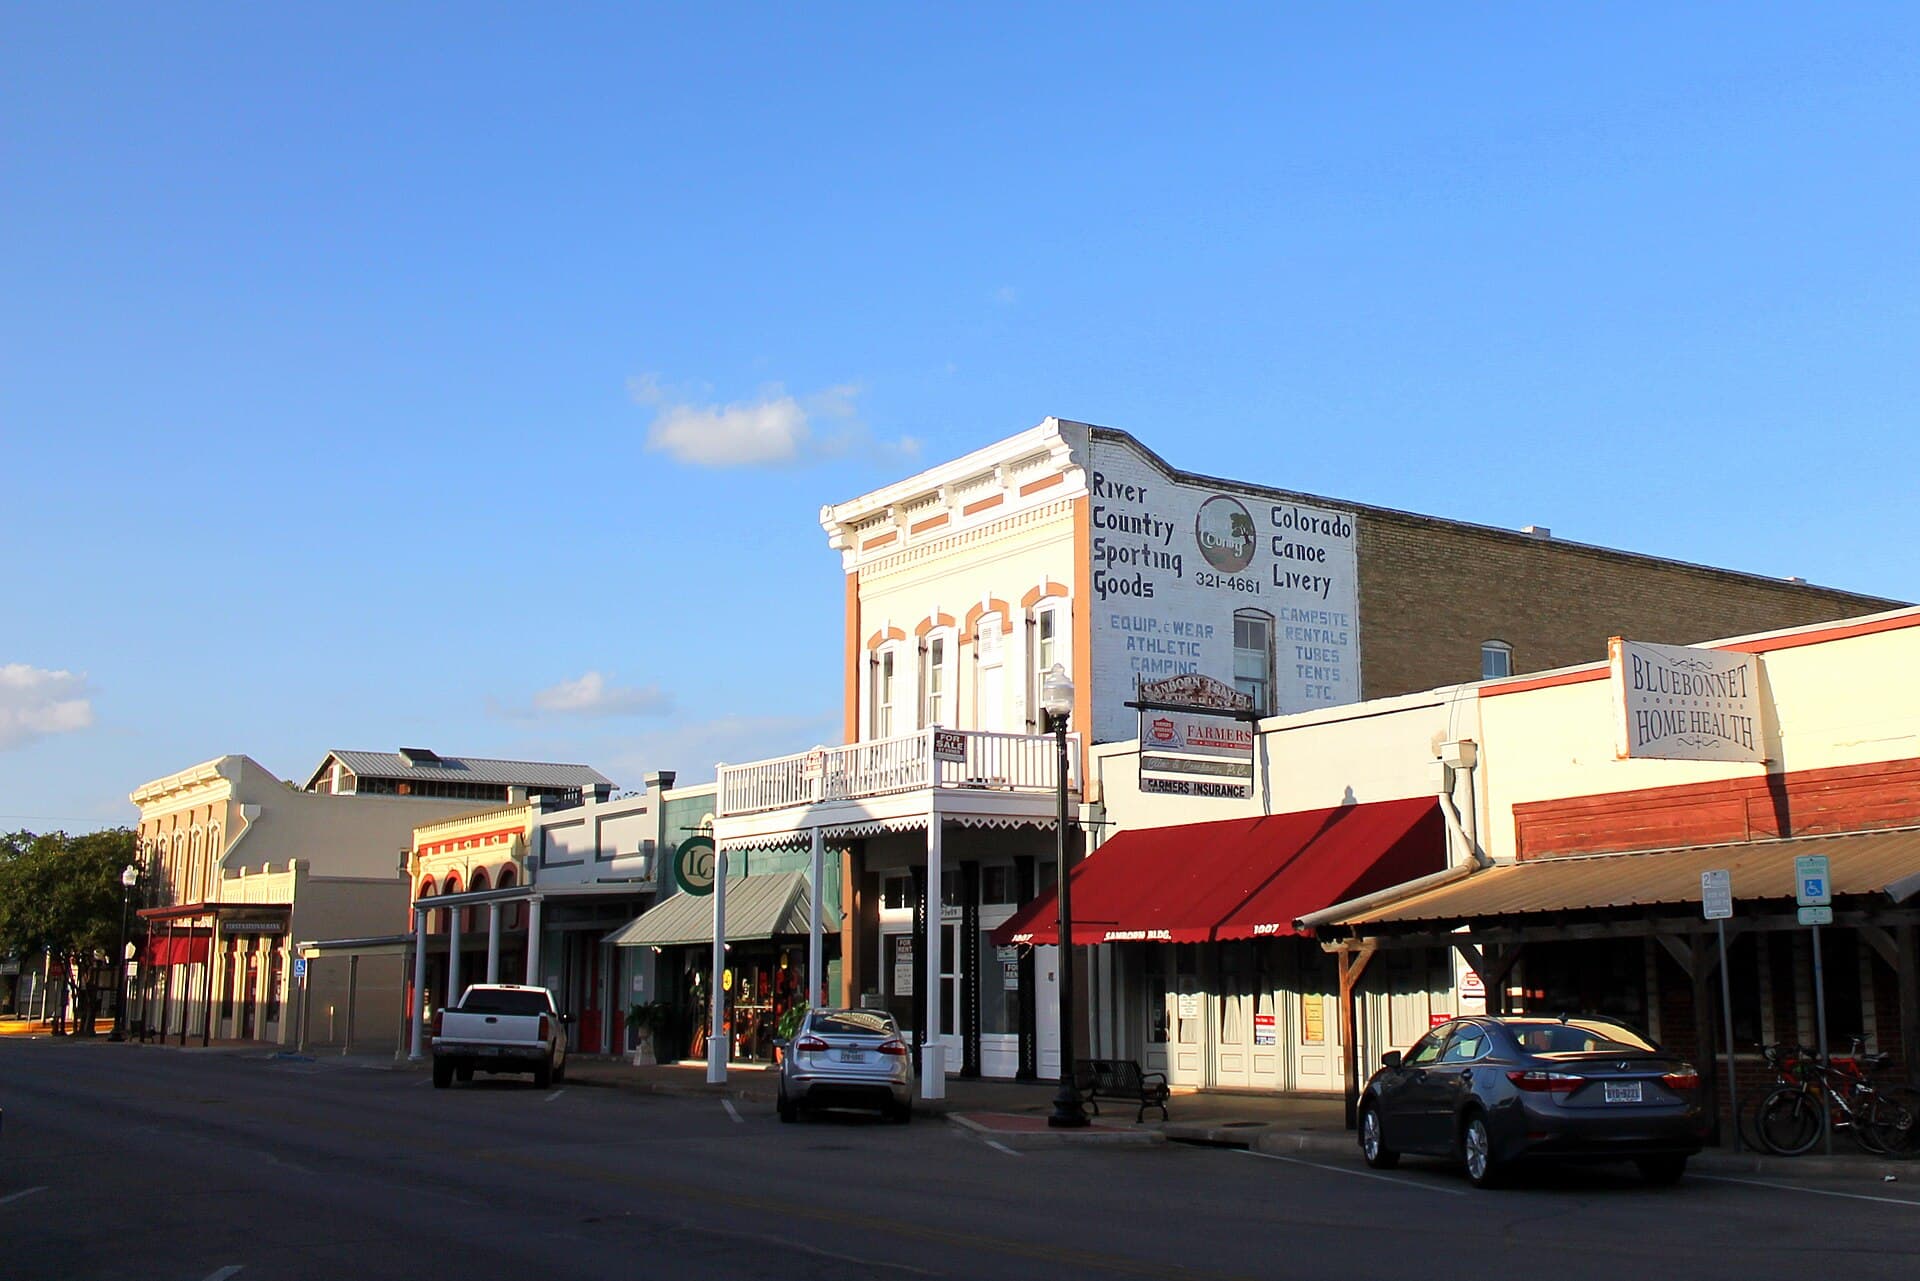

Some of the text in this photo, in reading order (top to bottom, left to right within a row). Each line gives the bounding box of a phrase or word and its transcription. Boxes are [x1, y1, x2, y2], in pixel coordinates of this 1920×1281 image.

[1093, 471, 1147, 503] River
[1093, 505, 1174, 546] Country
[1271, 506, 1351, 538] Colorado
[1094, 537, 1182, 578] Sporting
[1272, 535, 1326, 563] Canoe
[1094, 570, 1154, 600] Goods
[1195, 572, 1260, 594] 321-4661
[1273, 563, 1331, 600] Livery
[1111, 614, 1161, 633] EQUIP.
[1173, 621, 1214, 640] WEAR
[1280, 607, 1349, 627] CAMPSITE
[1286, 626, 1347, 646] RENTALS
[1127, 636, 1200, 657] ATHLETIC
[1296, 645, 1339, 663] TUBES
[1130, 656, 1198, 676] CAMPING
[1296, 663, 1340, 681] TENTS
[1631, 653, 1747, 698] BLUEBONNET
[1144, 676, 1200, 696] SANBORN
[1305, 684, 1336, 700] ETC.
[940, 734, 960, 742] FOR
[1187, 725, 1252, 741] FARMERS
[1636, 709, 1754, 751] HOME HEALTH
[936, 740, 963, 750] SALE
[1148, 778, 1245, 798] FARMERS INSURANCE
[1104, 930, 1146, 941] SANBORN
[1253, 924, 1279, 934] 1007
